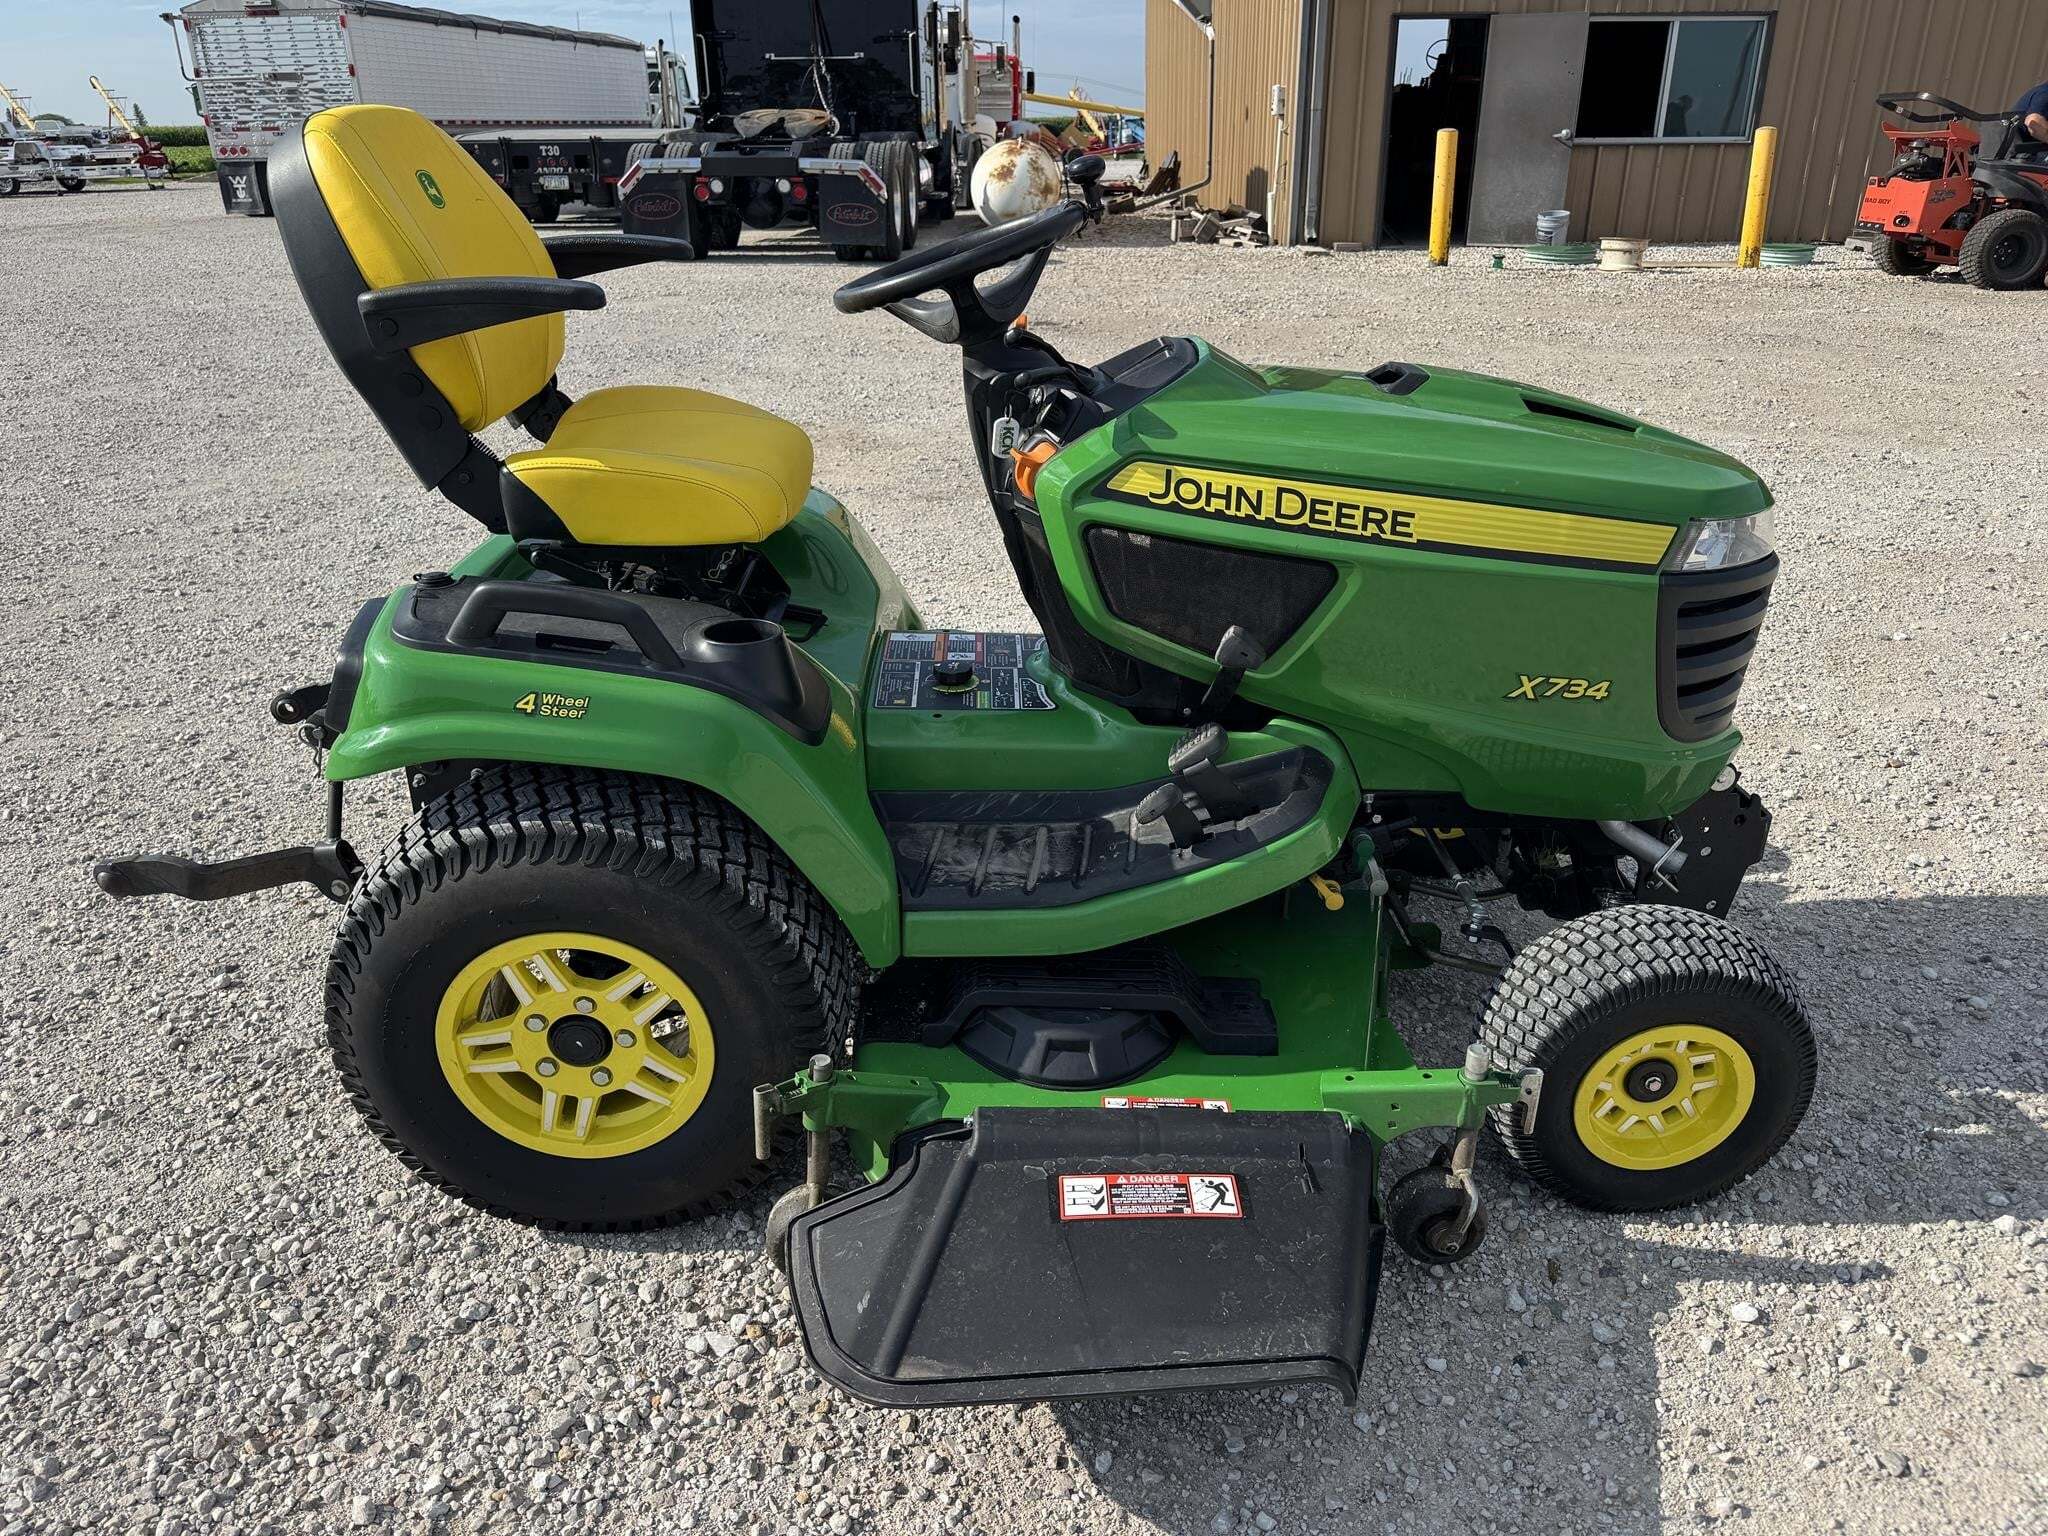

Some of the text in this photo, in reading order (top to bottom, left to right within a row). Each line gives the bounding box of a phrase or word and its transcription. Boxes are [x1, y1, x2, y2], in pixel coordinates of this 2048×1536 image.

[539, 145, 560, 156] T30
[1148, 469, 1416, 538] JOHN DEERE
[1505, 675, 1611, 700] X734
[515, 693, 589, 713] 4 Wheel
[539, 705, 585, 718] Steer
[1129, 1175, 1178, 1183] DANGER
